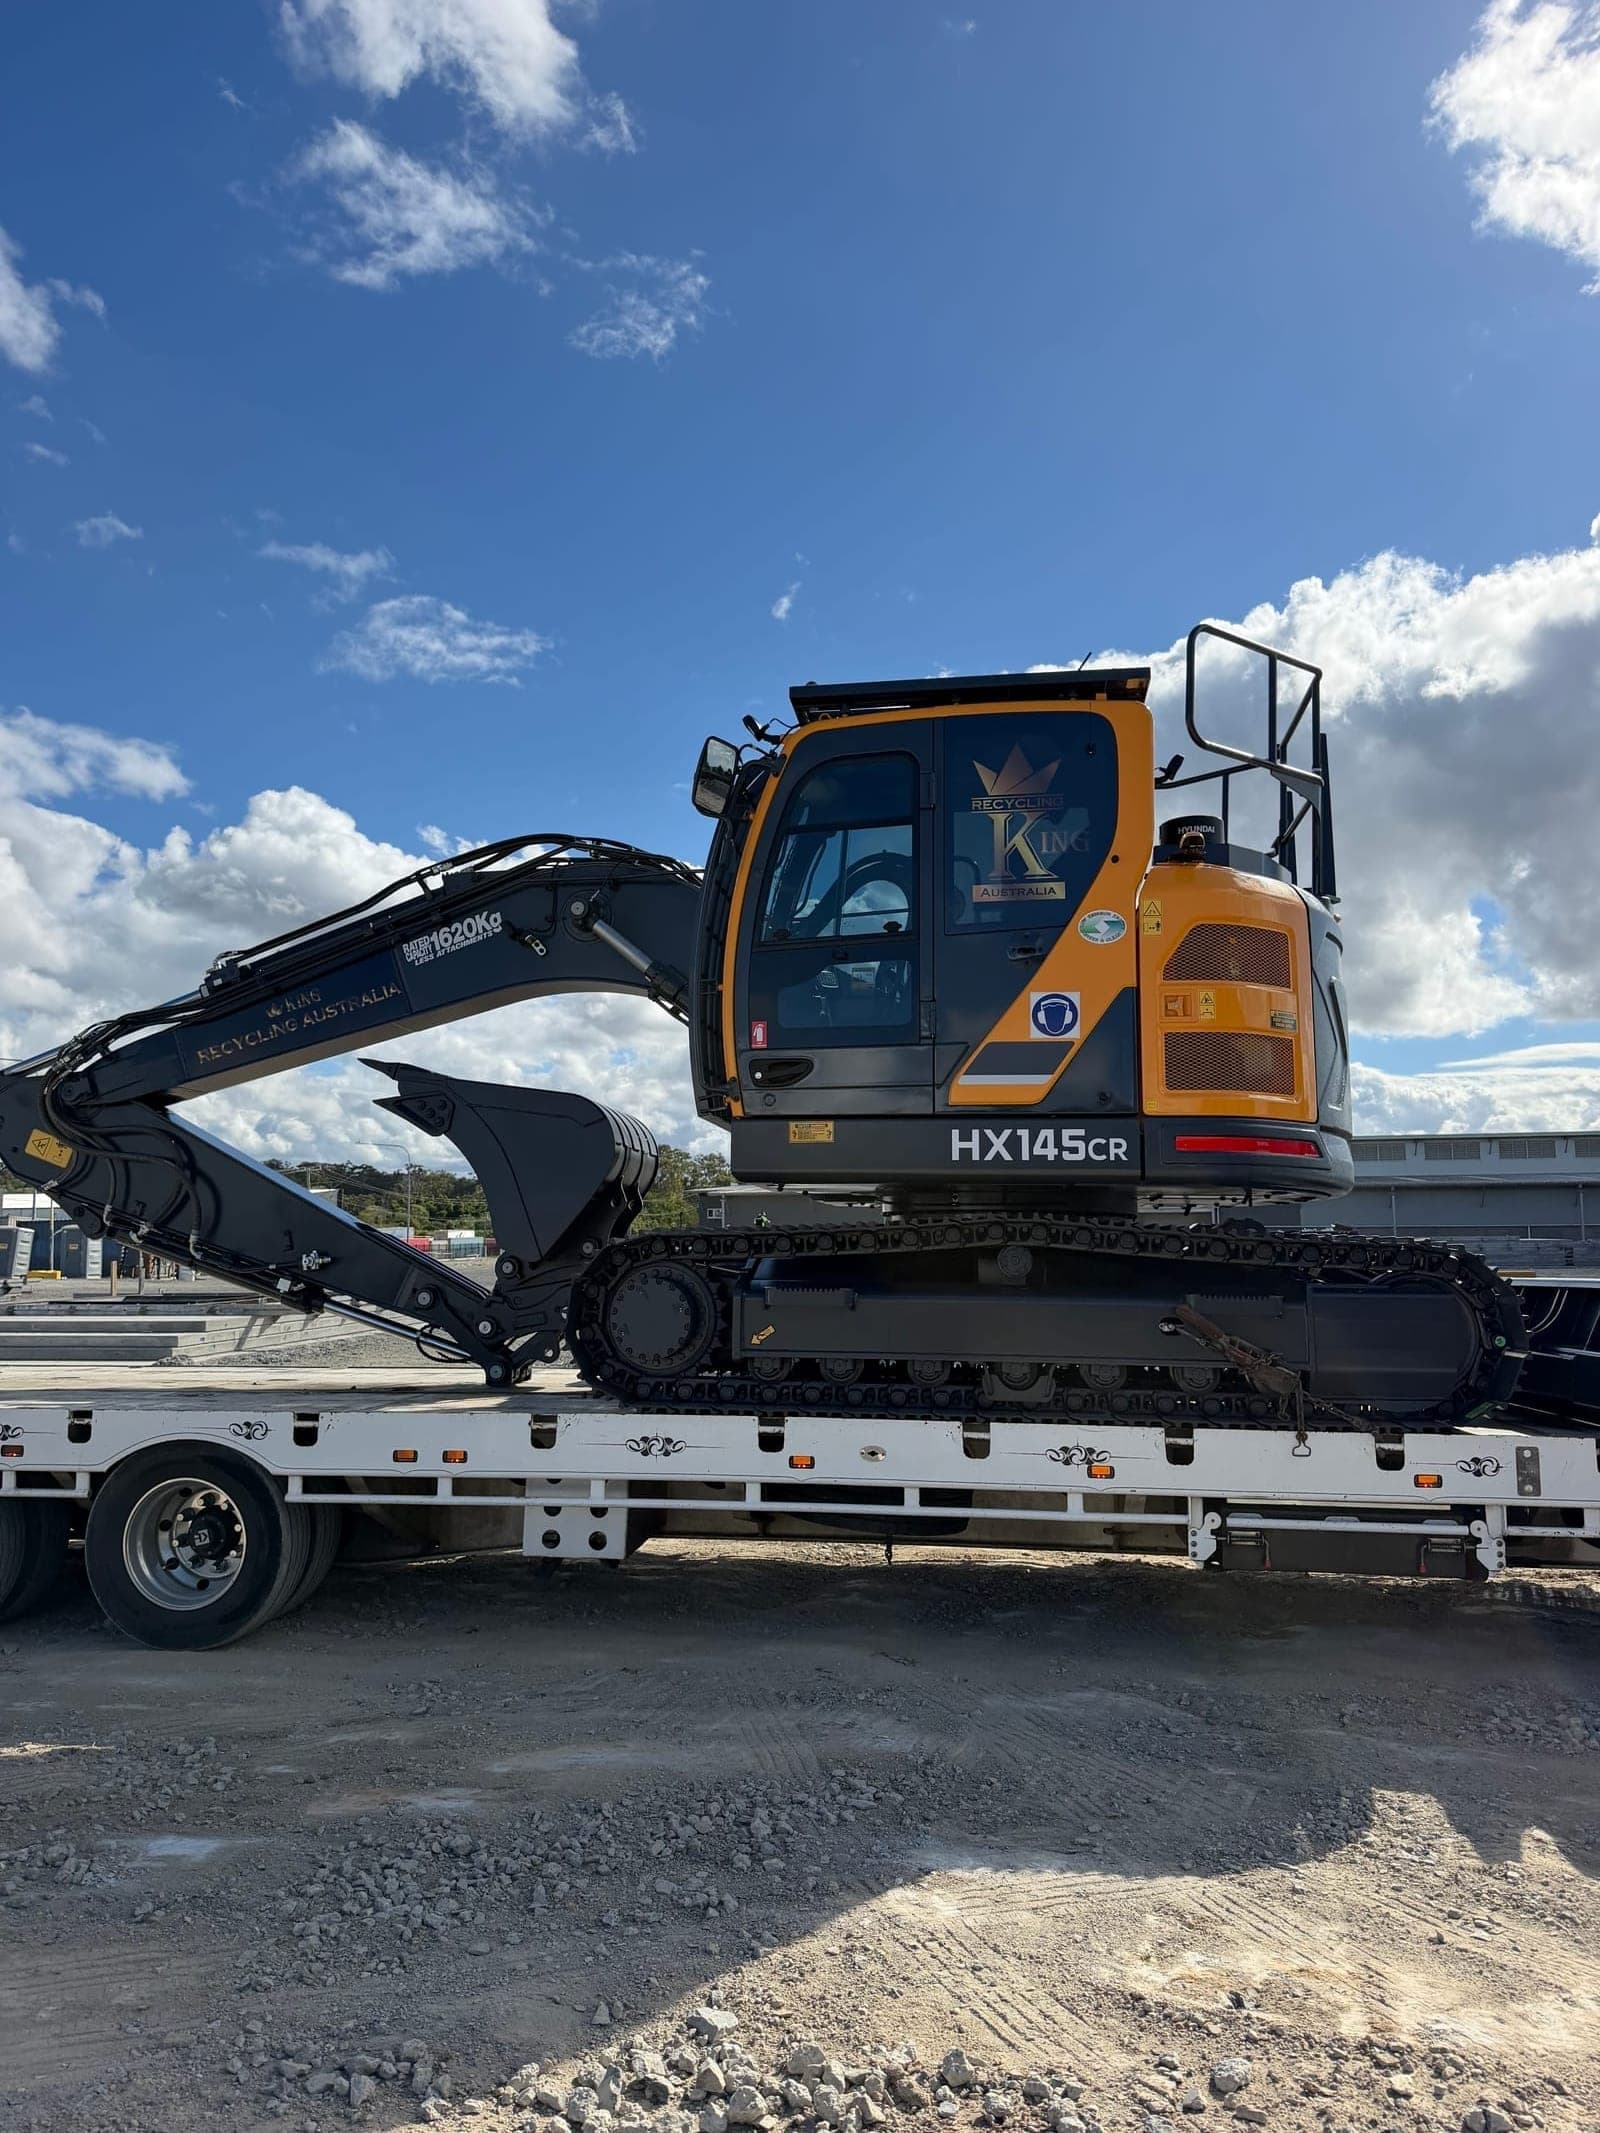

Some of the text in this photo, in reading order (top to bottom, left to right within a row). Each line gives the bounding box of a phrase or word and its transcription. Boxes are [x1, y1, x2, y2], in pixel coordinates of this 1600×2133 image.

[971, 798, 1063, 811] RECYCLING
[1178, 824, 1215, 834] HYUNDAI
[980, 886, 1056, 897] AUSTRALIA
[431, 910, 502, 951] 1620Kg
[402, 935, 429, 953] RATED
[415, 930, 493, 966] LESS ATTACHMENTS
[196, 982, 402, 1065] RECYCLING AUSTRALIA
[951, 1129, 1128, 1161] HX145CR
